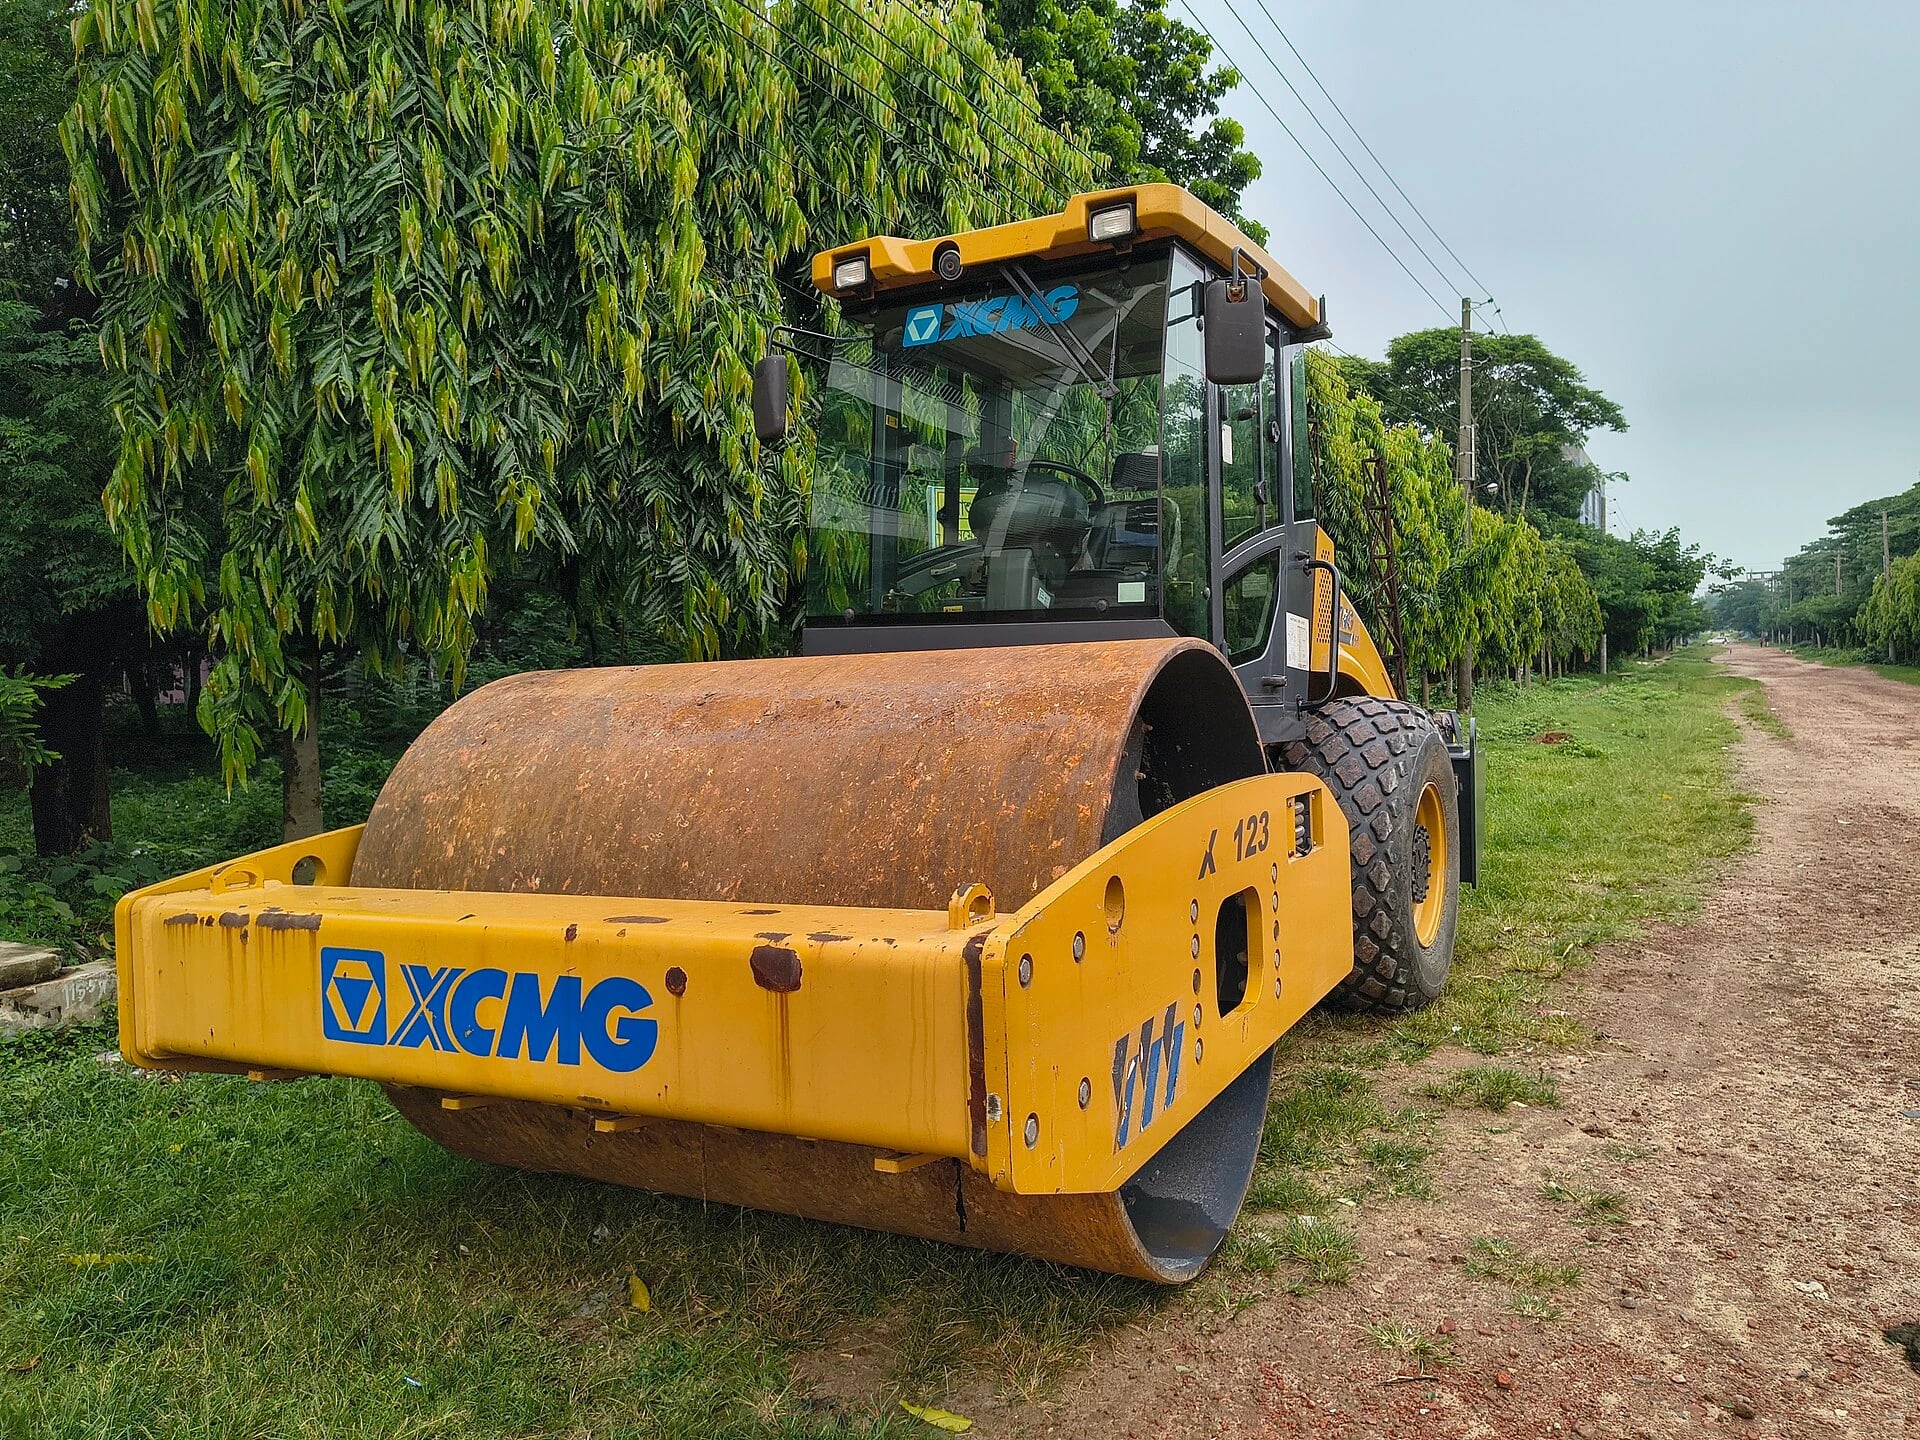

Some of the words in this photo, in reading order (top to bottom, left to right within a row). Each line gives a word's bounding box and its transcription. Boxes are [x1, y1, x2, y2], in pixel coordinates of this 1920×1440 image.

[938, 285, 1079, 342] XCMG
[1233, 810, 1269, 862] 123
[387, 963, 658, 1073] XCMG
